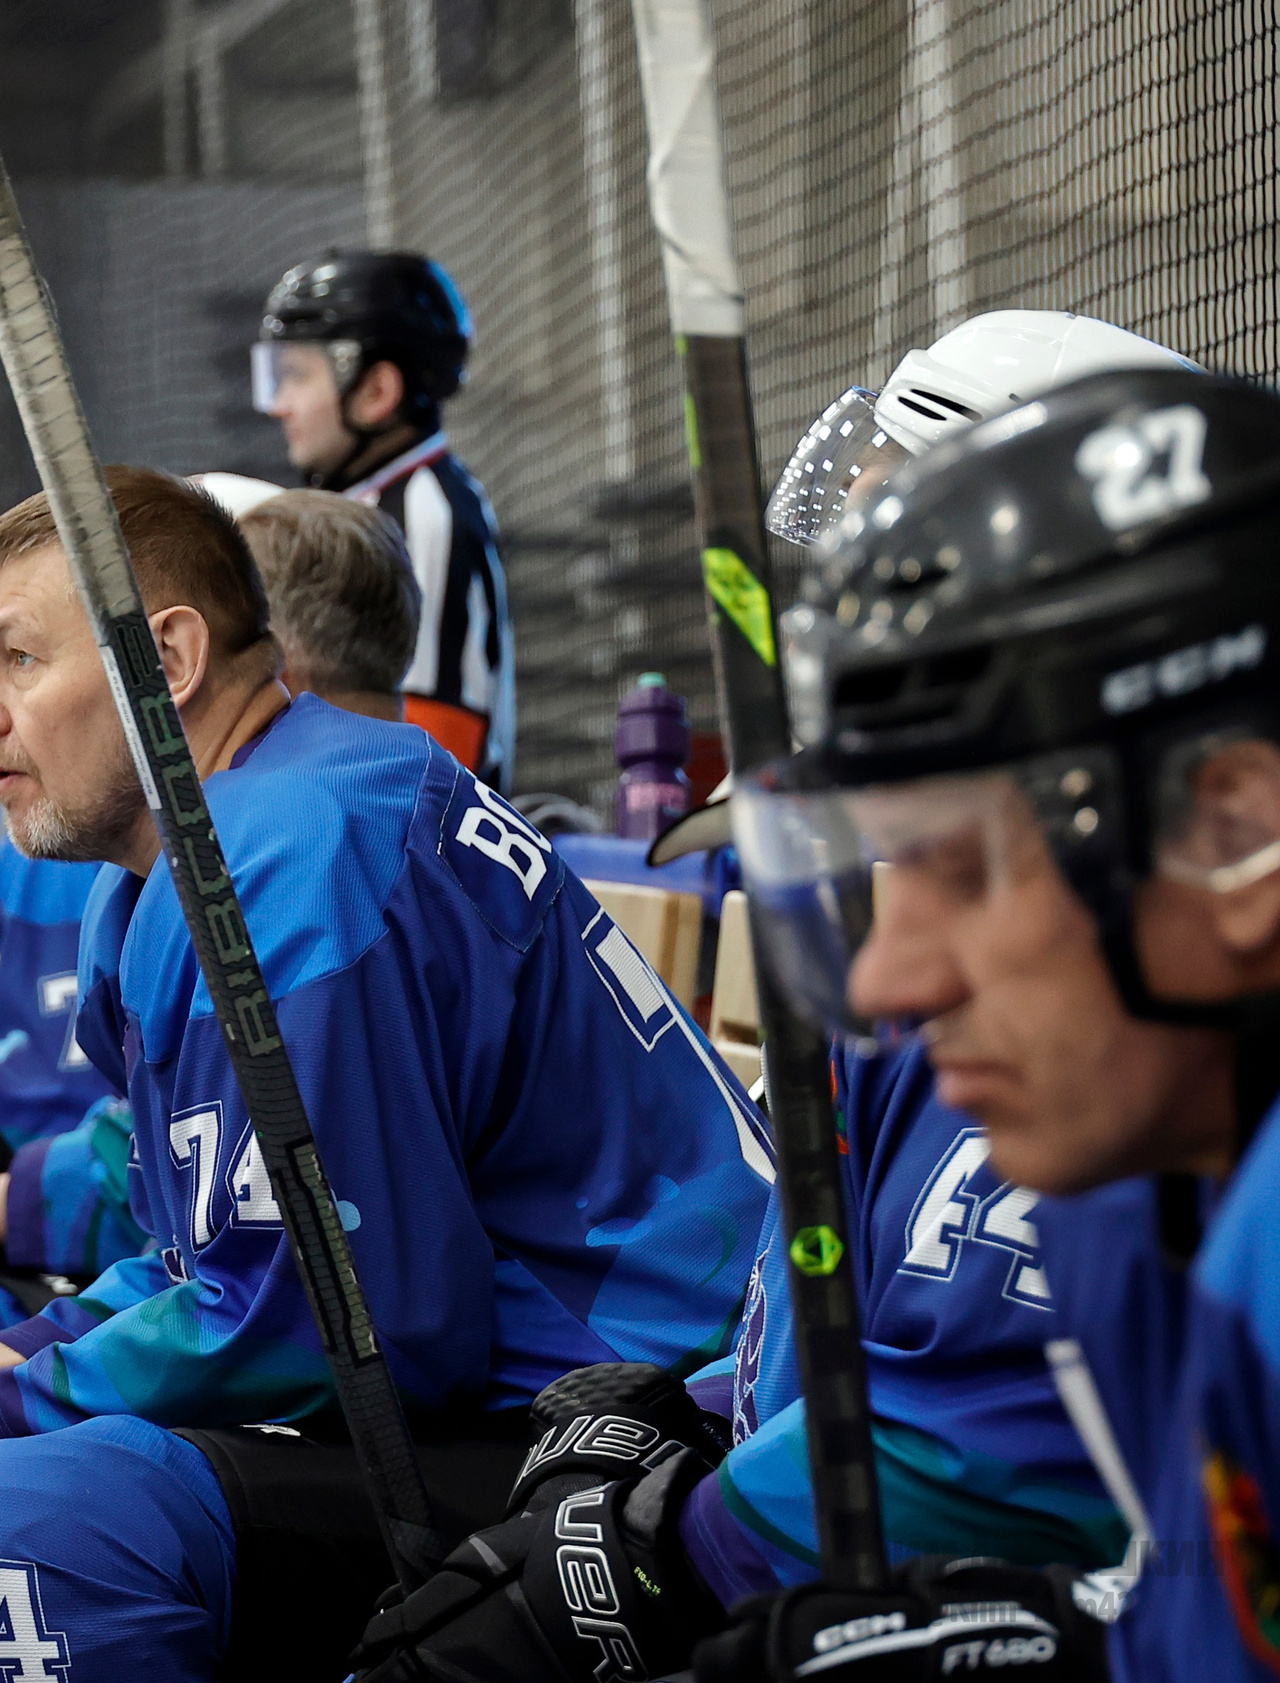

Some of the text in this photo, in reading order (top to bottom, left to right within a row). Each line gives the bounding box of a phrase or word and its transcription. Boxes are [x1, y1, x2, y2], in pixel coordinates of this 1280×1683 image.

[1075, 402, 1213, 532] 27
[140, 689, 283, 1057] RIBCOR
[814, 1612, 906, 1654] CCM
